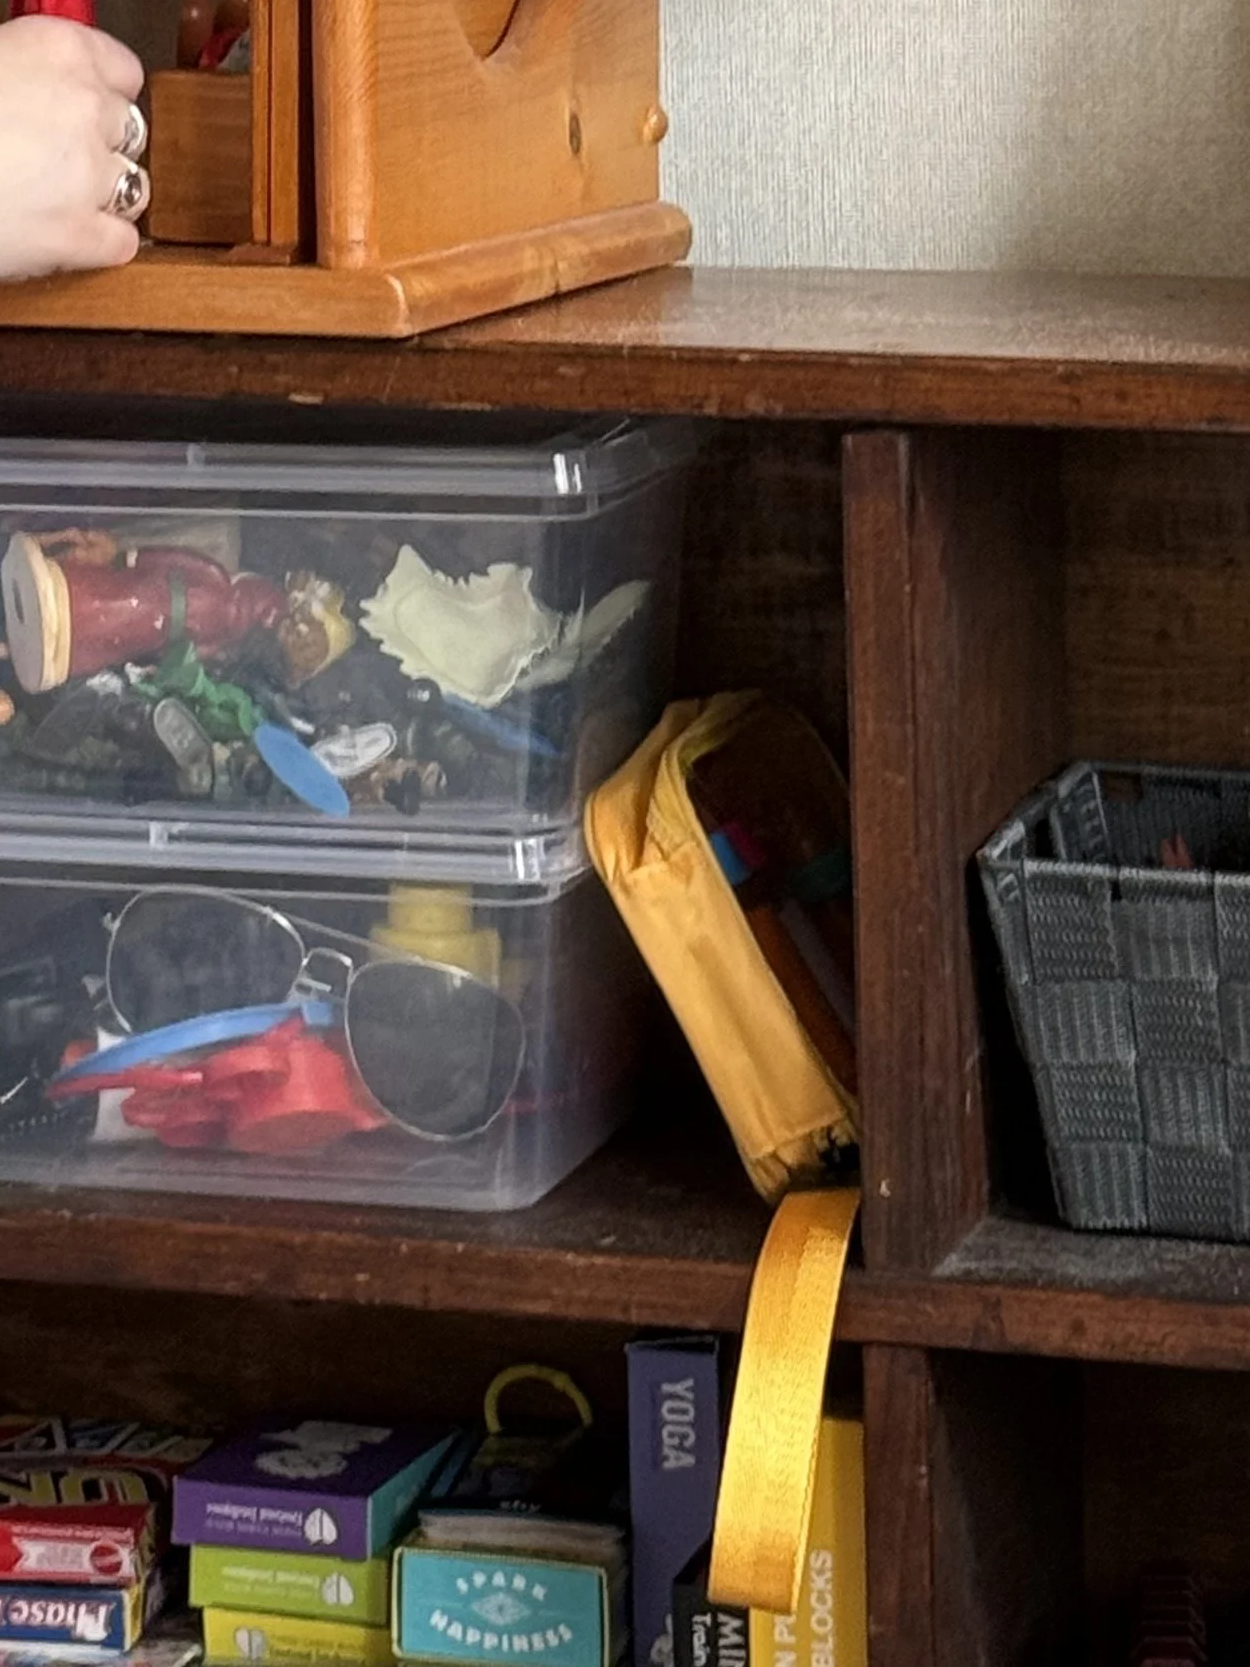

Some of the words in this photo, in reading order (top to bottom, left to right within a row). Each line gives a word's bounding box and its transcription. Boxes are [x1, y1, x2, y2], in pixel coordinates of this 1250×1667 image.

[661, 1378, 696, 1471] YOGA
[456, 1570, 548, 1602] SPARK
[808, 1549, 835, 1667] BLOCKS
[10, 1600, 116, 1642] Phase
[429, 1608, 574, 1655] HAPPINESS
